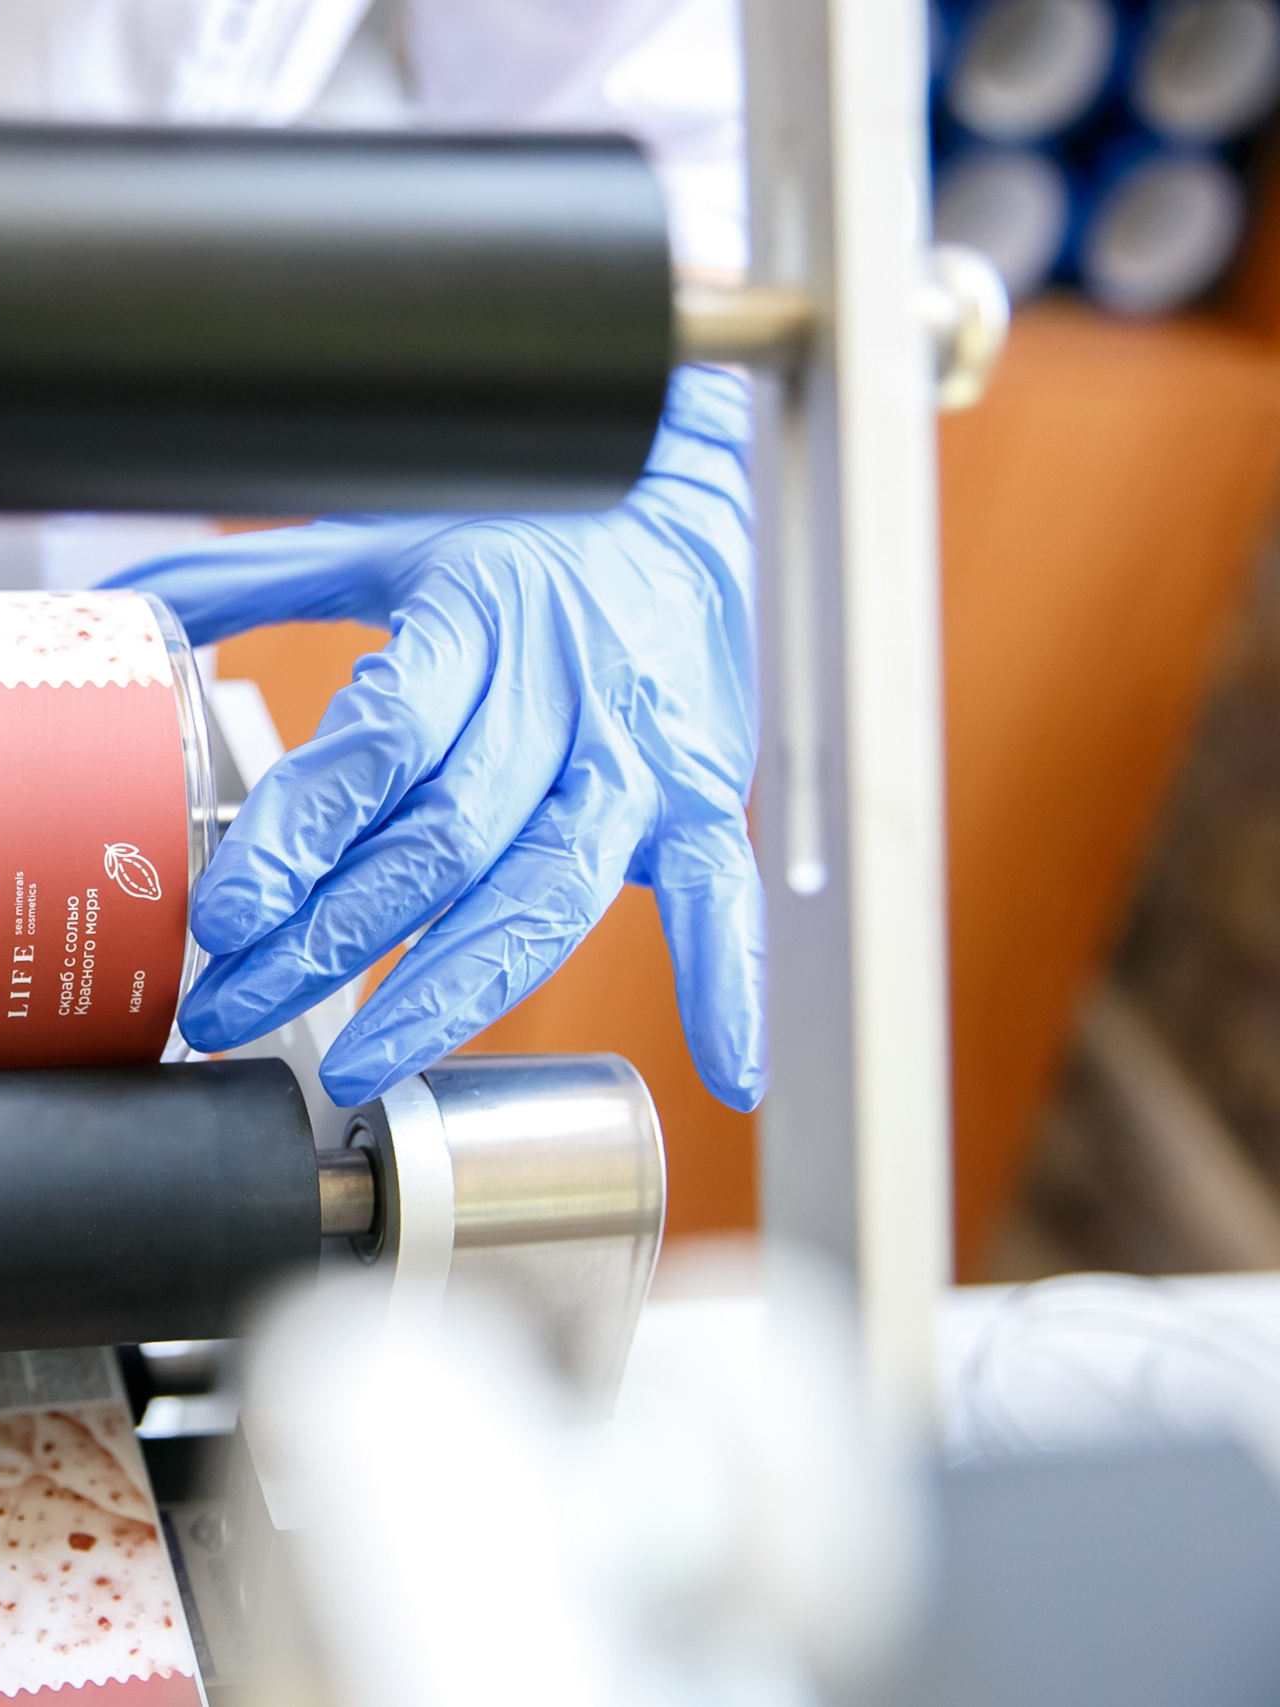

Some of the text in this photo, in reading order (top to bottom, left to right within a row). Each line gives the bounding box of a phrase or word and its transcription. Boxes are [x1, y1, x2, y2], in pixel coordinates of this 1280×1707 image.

[14, 870, 24, 936] sea minerals
[27, 883, 36, 936] cosmetics
[7, 945, 35, 1018] LIFE
[58, 895, 79, 1016] скраб с солью
[74, 888, 100, 1015] Красного моря
[129, 970, 146, 1013] какао
